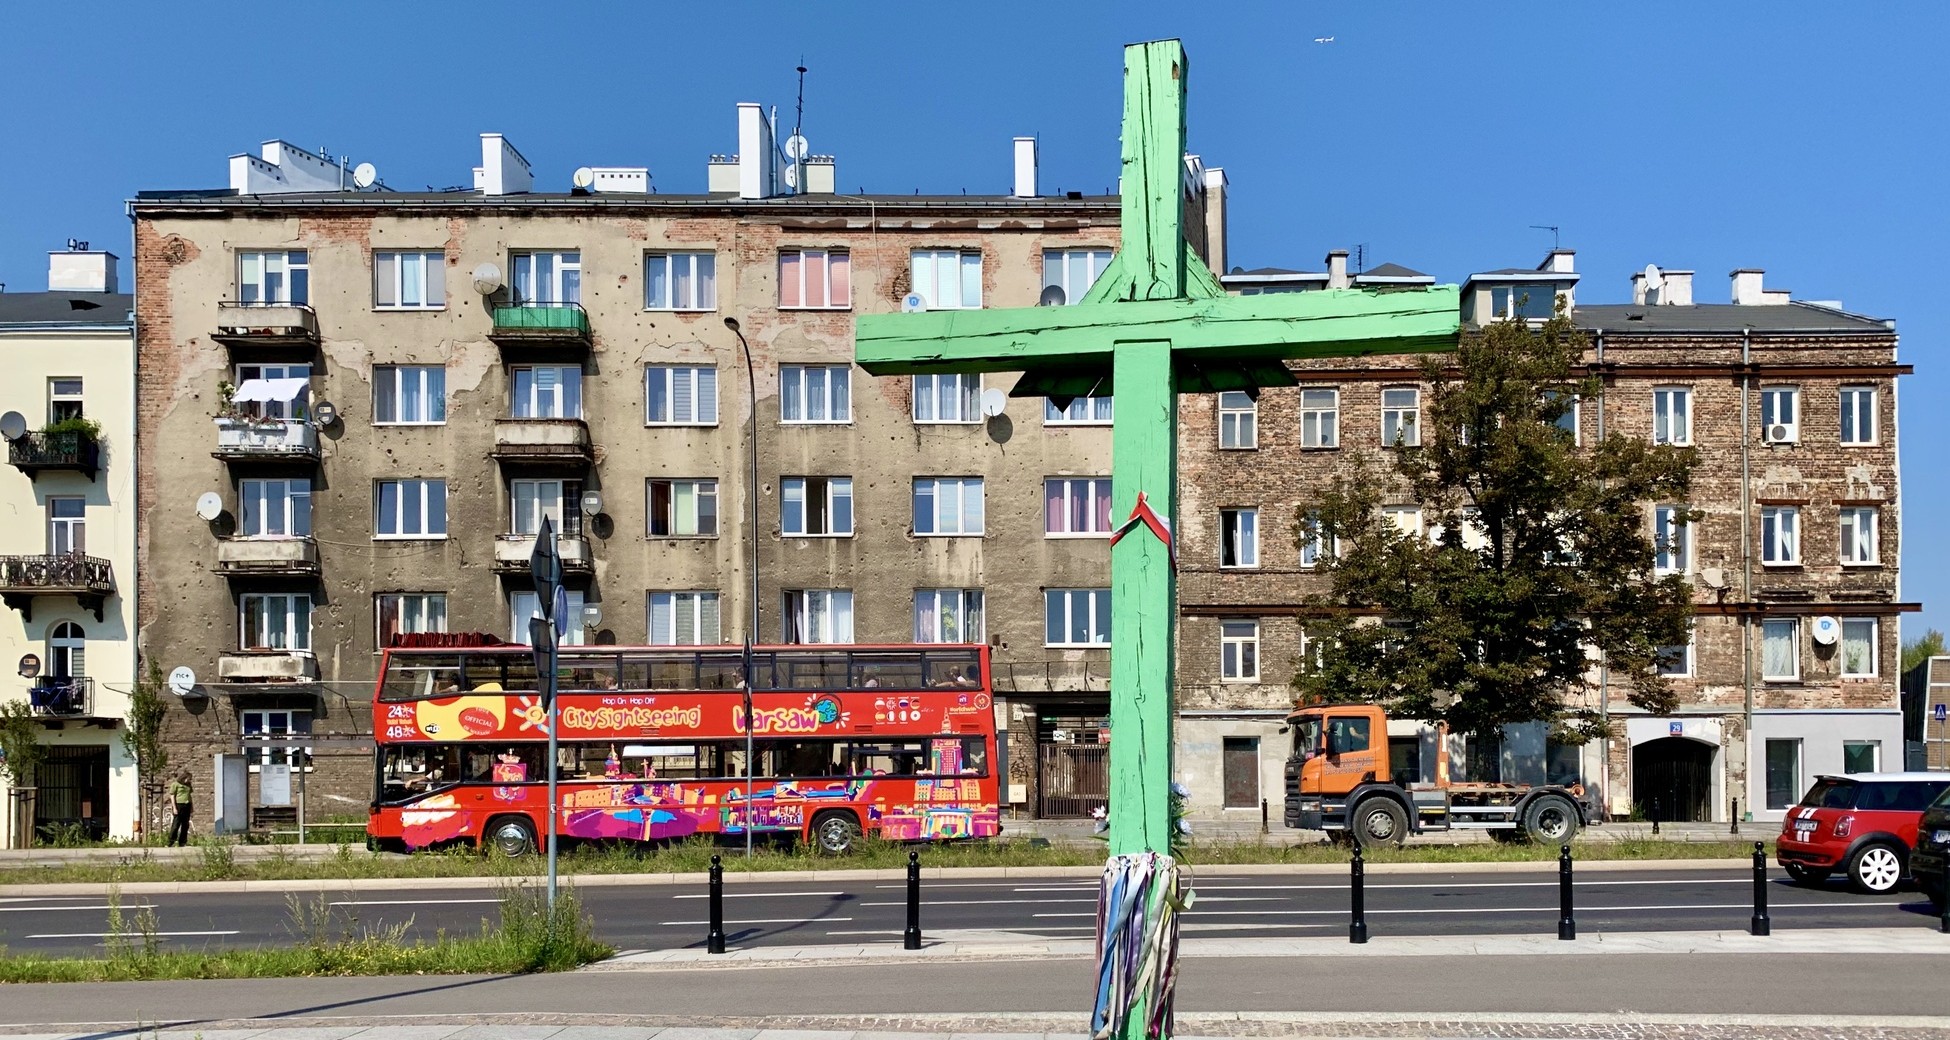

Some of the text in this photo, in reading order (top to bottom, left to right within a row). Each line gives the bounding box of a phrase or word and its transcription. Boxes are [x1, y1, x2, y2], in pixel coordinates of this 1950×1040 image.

[602, 697, 615, 705] Hop
[629, 697, 643, 705] Hop
[387, 705, 402, 719] 24
[464, 715, 493, 728] OFFICIAL
[386, 725, 403, 739] 48
